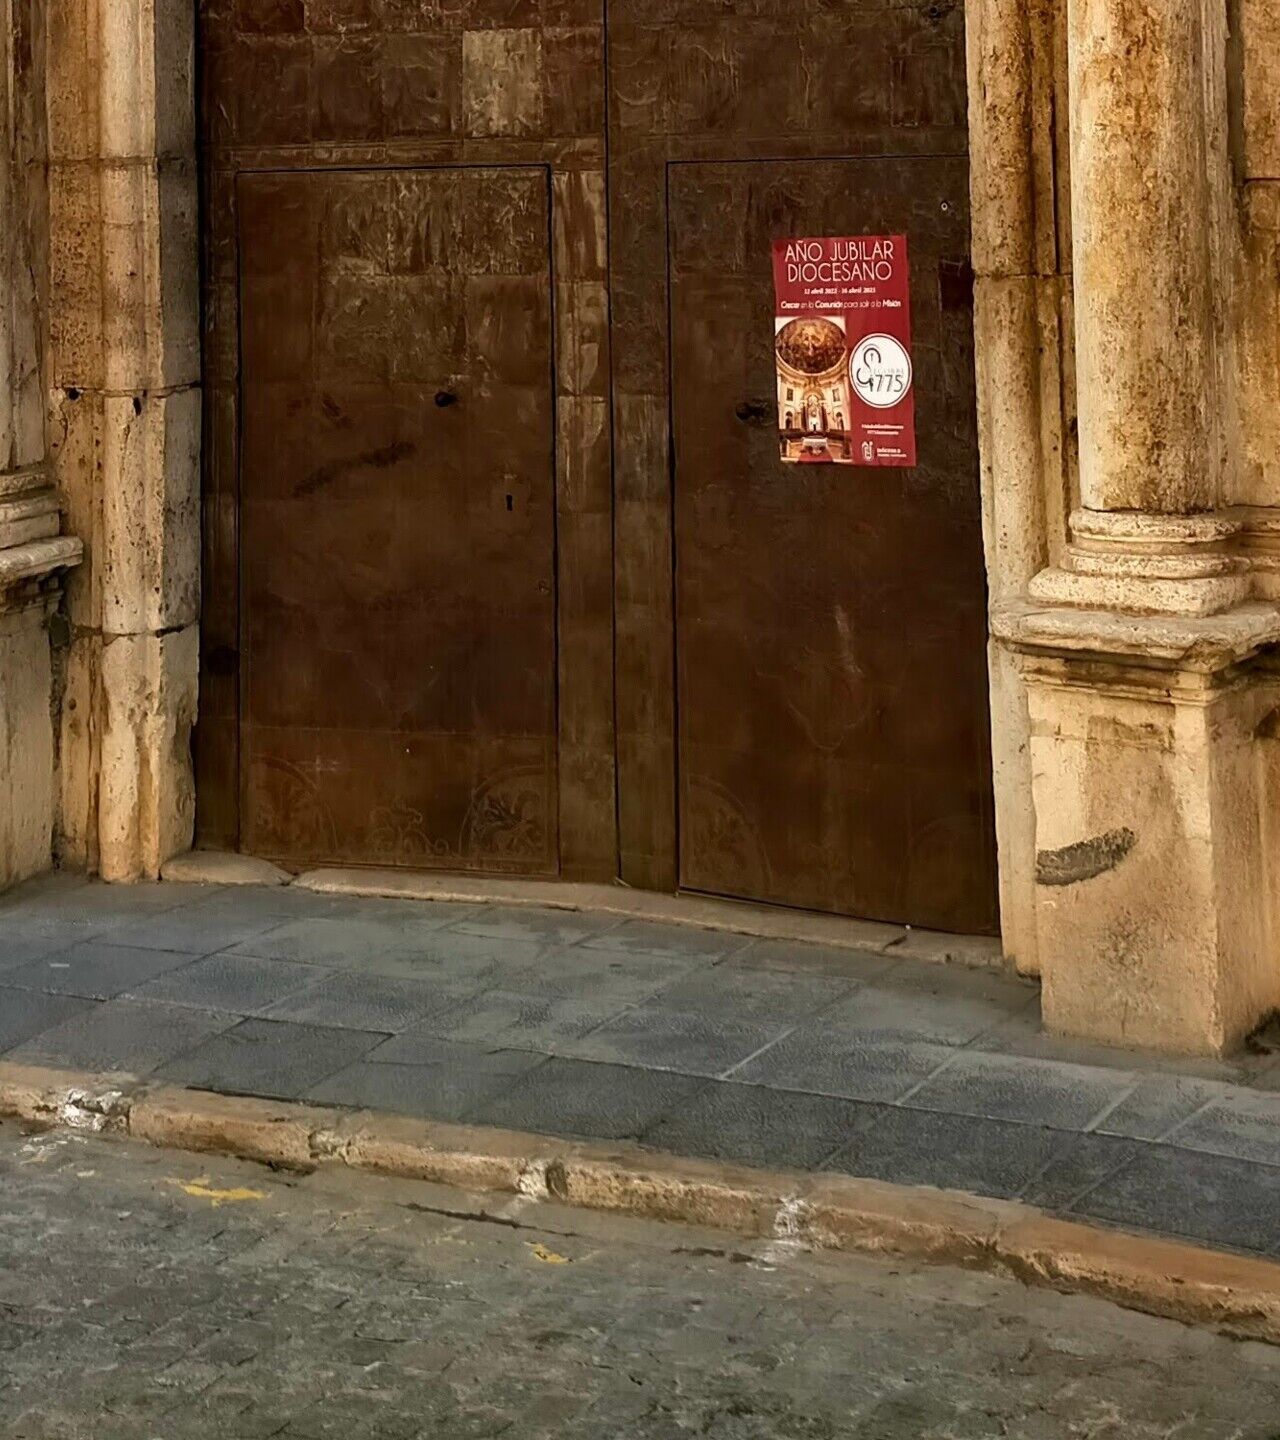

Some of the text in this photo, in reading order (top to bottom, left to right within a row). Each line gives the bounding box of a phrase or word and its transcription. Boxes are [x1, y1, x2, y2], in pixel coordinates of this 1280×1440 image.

[785, 240, 894, 262] AÑO JUBILAR
[787, 261, 892, 283] DIOCESANO
